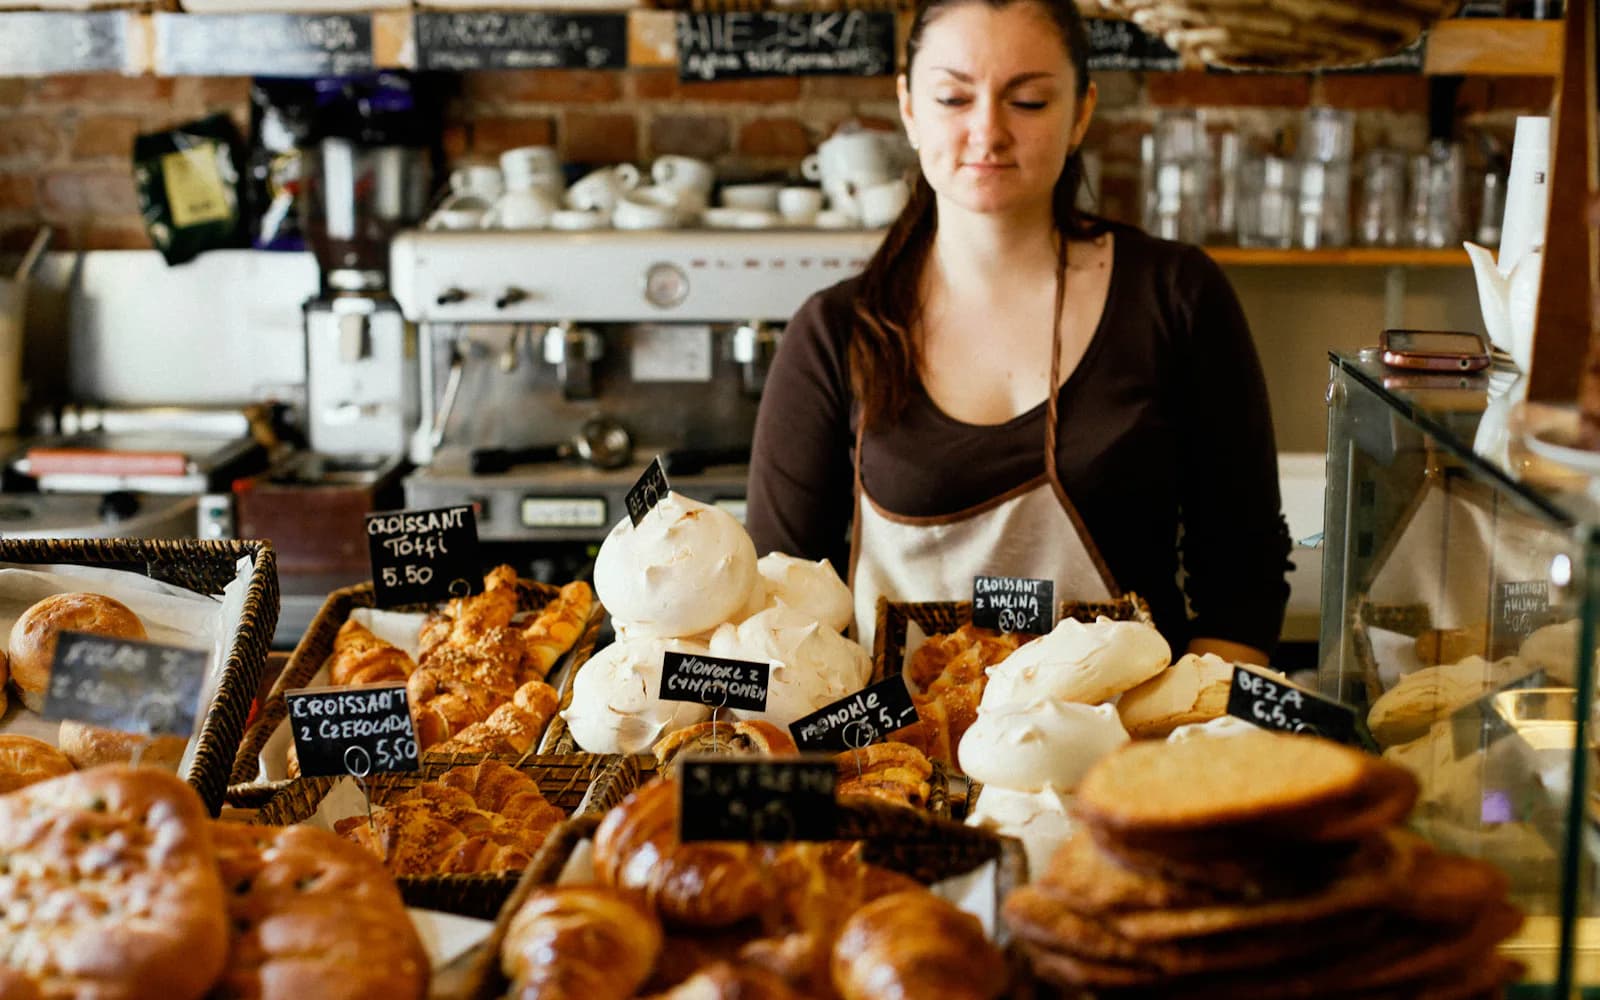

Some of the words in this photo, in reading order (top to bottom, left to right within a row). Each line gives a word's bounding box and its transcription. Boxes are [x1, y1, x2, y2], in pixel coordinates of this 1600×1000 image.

[368, 507, 469, 535] CROISSANT
[382, 564, 433, 587] 5.50
[976, 578, 1042, 594] CROISSANT
[288, 689, 407, 717] CROISSANT
[375, 737, 418, 770] 5,50
